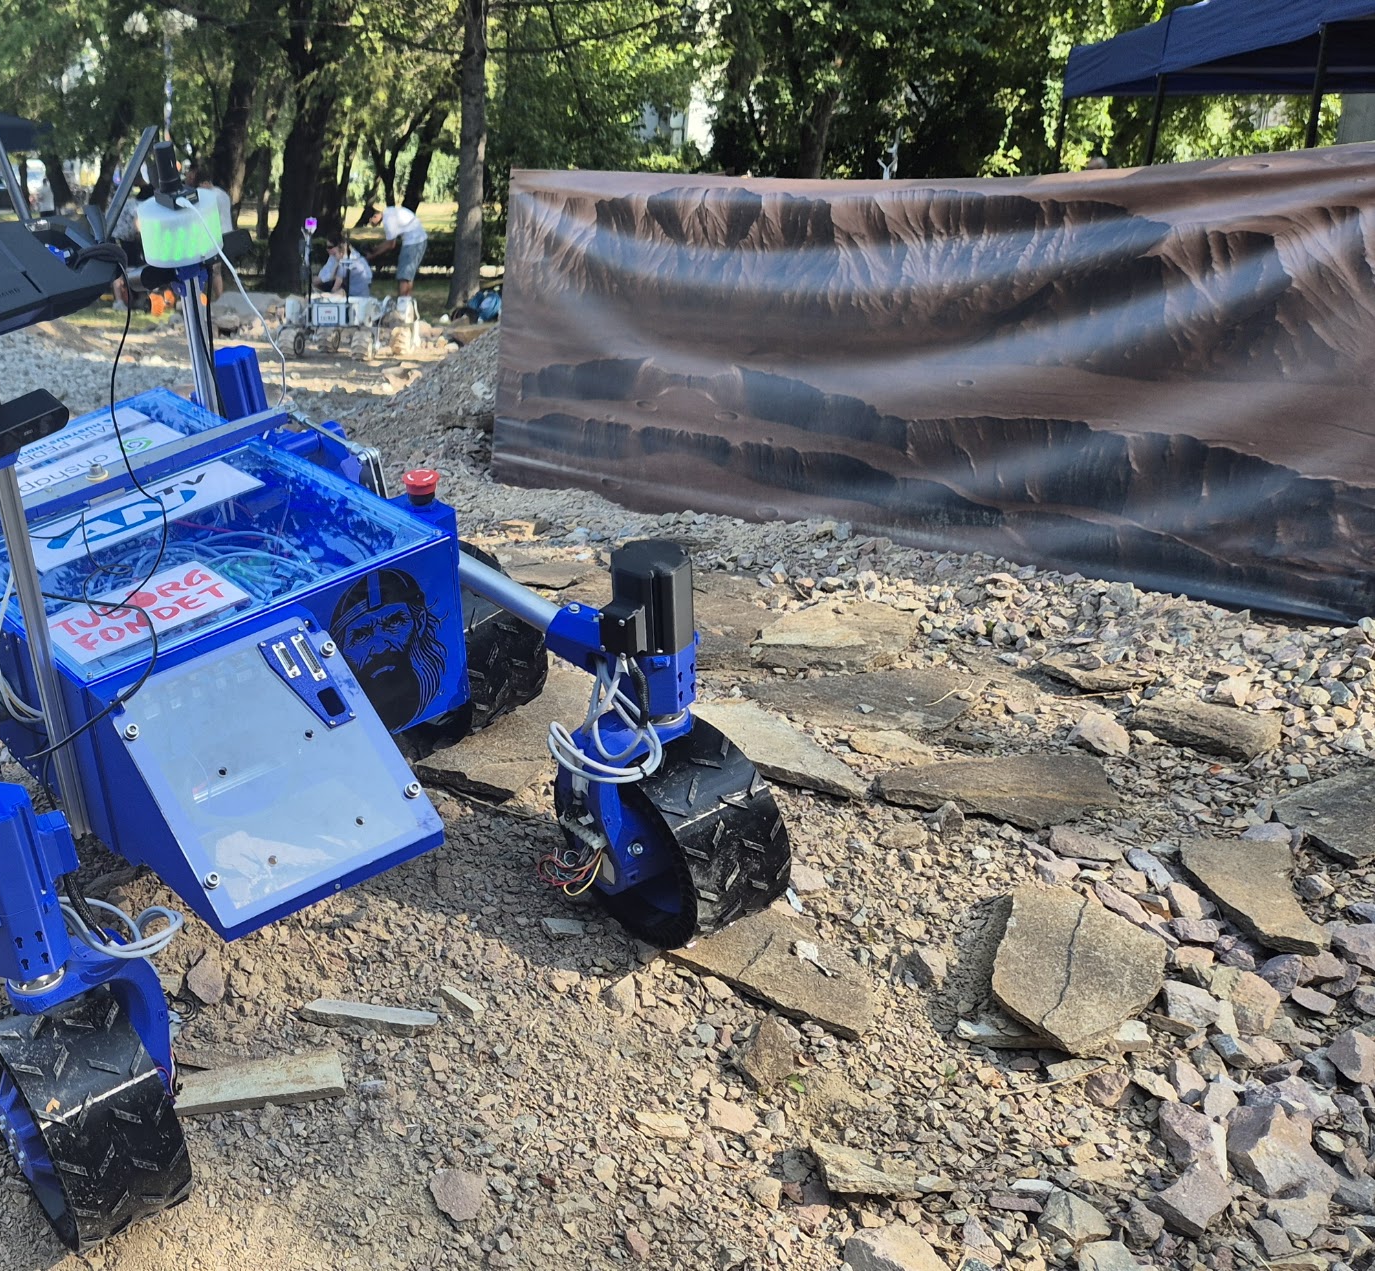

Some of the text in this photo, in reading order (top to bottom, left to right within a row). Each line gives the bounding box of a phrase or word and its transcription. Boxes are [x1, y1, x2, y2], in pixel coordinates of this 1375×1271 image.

[15, 440, 70, 467] PEDE
[19, 454, 108, 491] onshap
[73, 582, 224, 651] FONDET
